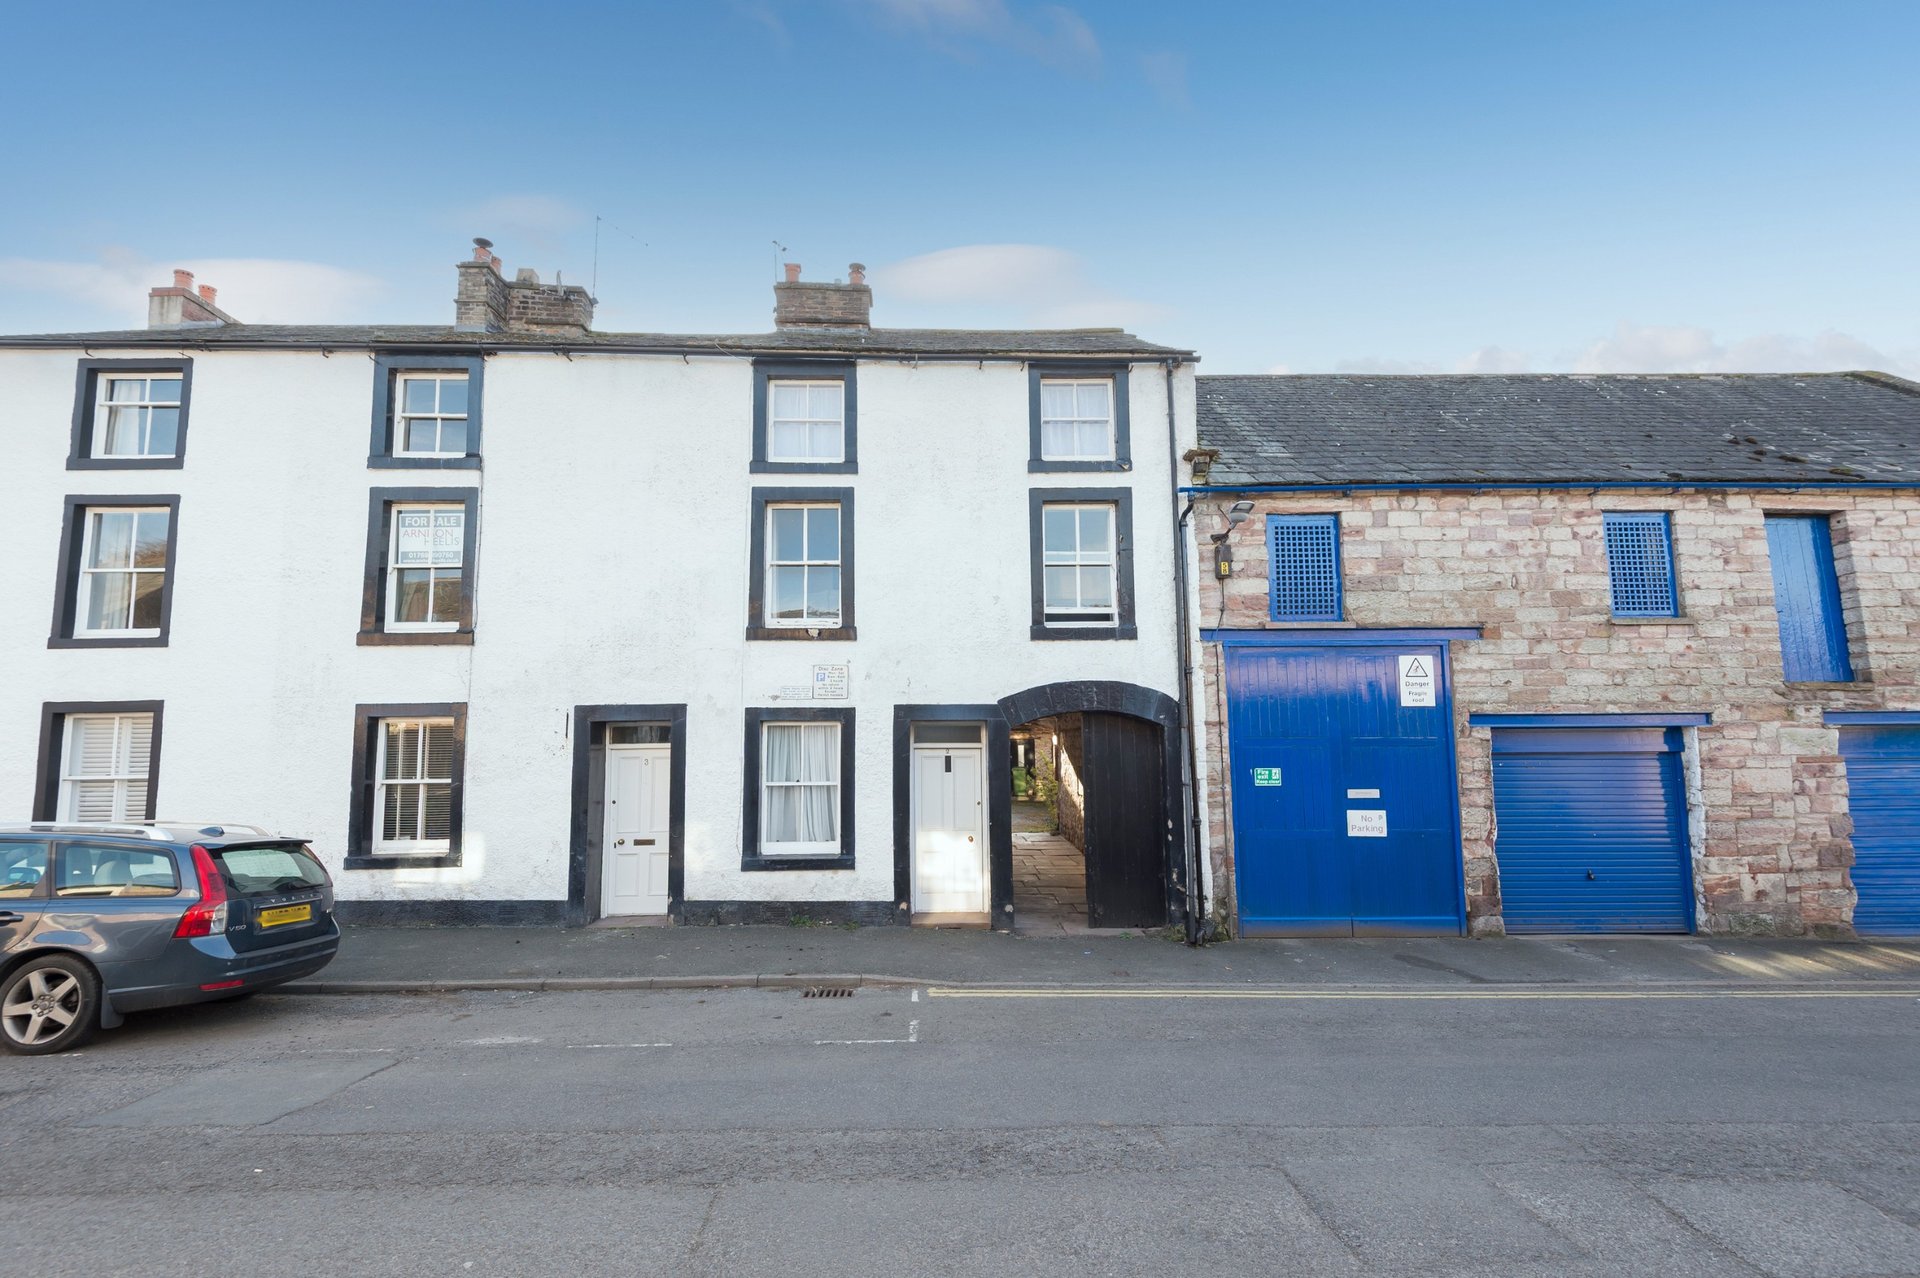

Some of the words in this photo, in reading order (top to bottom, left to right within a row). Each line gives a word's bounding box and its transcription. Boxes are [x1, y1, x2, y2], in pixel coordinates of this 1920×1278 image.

[405, 516, 428, 527] FOR
[402, 528, 454, 538] ARNION
[644, 758, 649, 766] 3
[1361, 815, 1373, 823] No
[1351, 824, 1384, 834] Parking
[228, 924, 247, 932] V50
